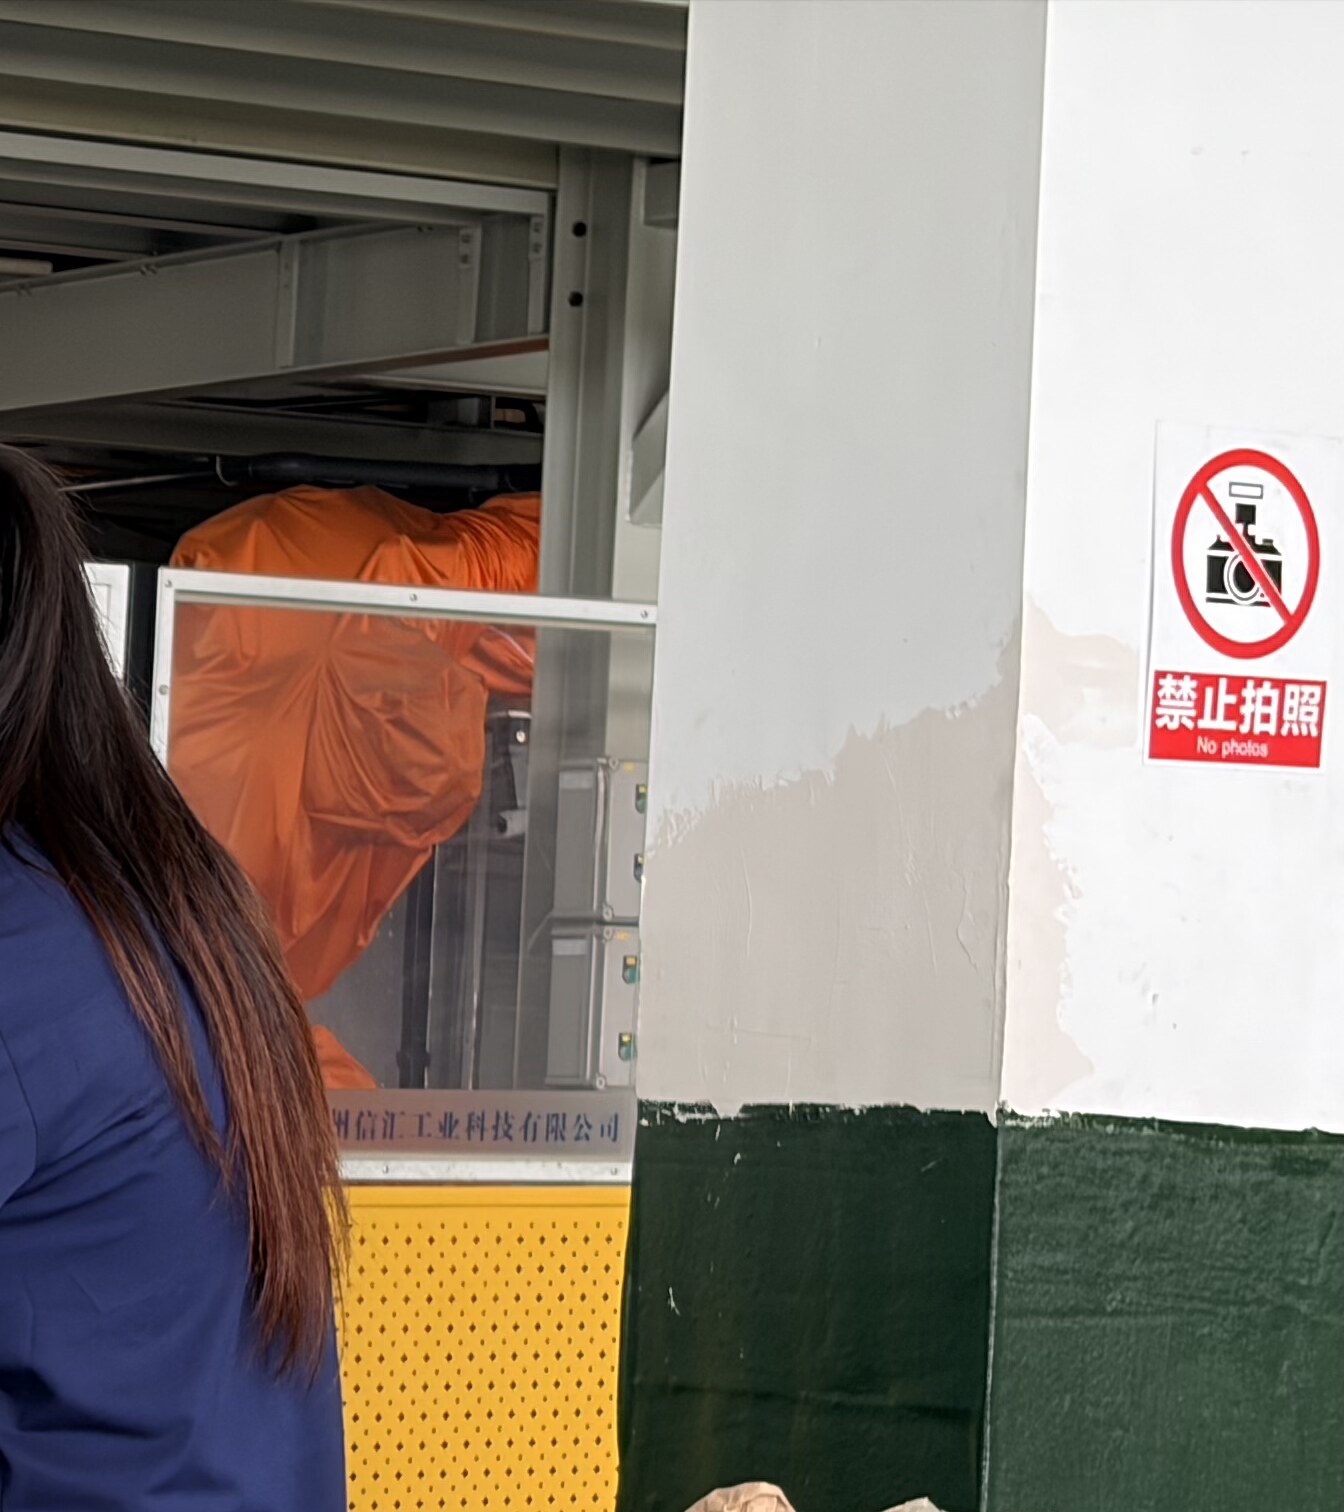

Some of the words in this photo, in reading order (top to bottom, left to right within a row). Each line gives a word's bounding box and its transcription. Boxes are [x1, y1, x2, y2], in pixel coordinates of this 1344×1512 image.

[1155, 673, 1322, 738] 禁止拍照
[1197, 735, 1217, 755] No
[1221, 738, 1269, 758] photos
